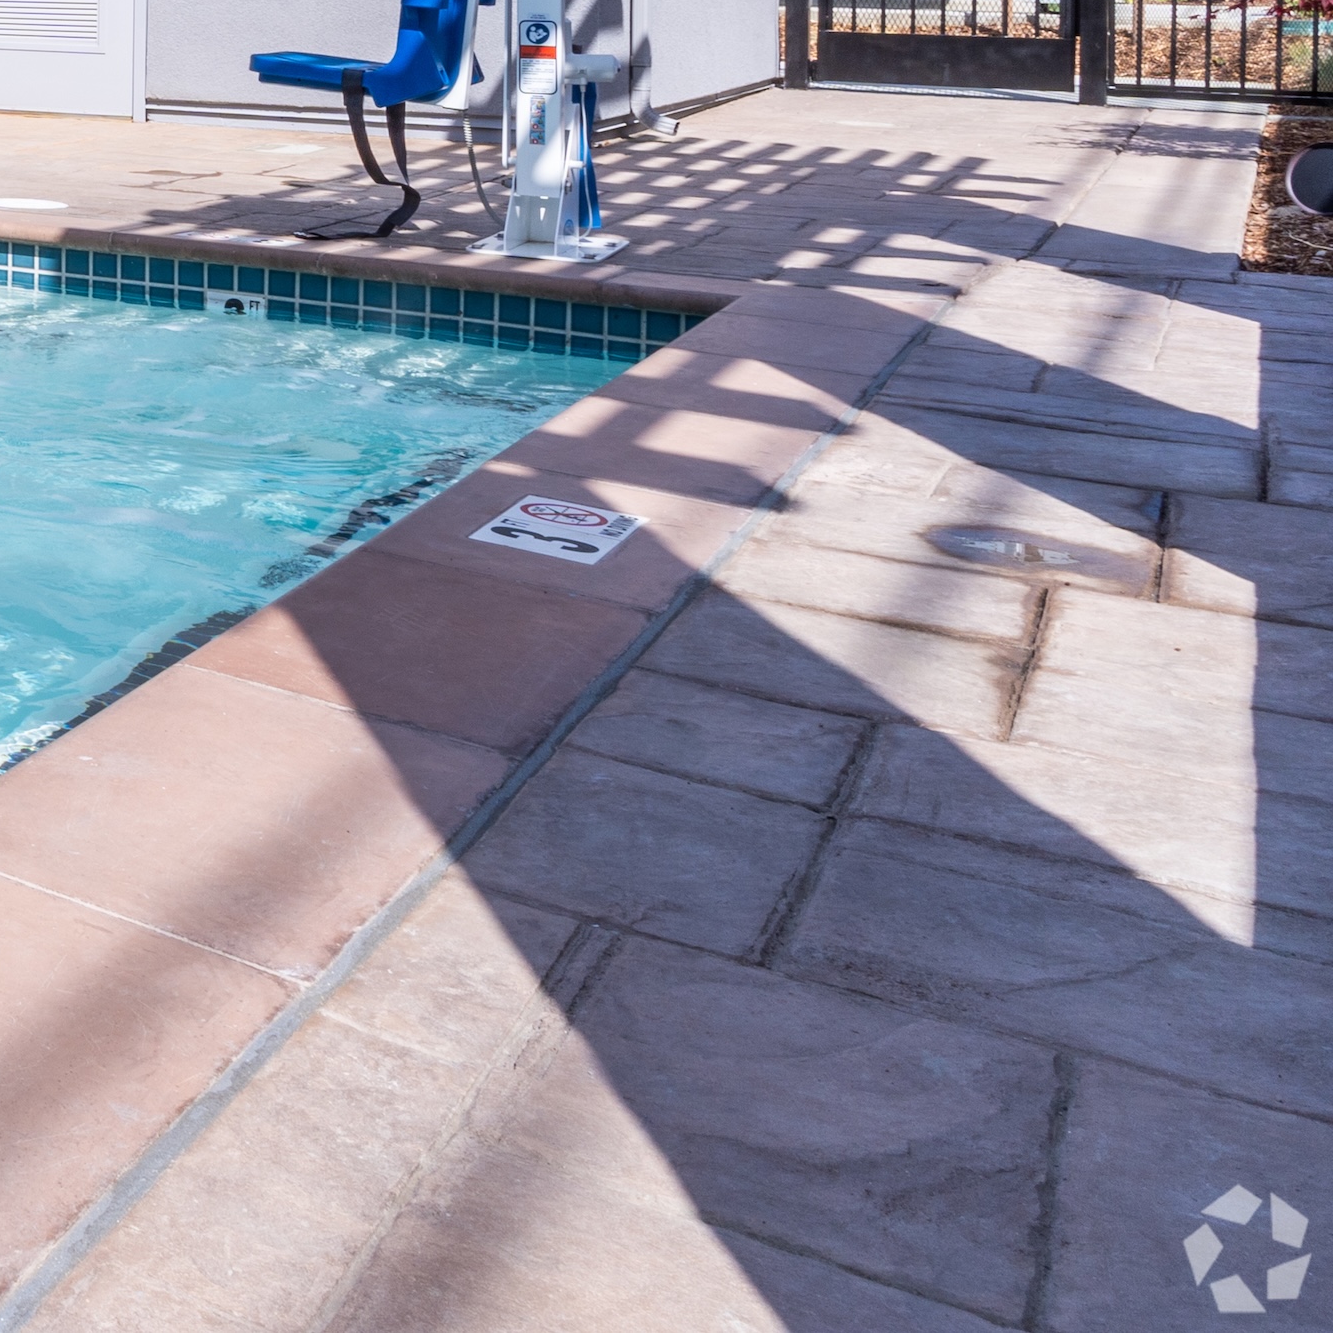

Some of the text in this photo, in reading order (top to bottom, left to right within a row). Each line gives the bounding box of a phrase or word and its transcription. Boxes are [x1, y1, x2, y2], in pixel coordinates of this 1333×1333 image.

[249, 300, 261, 311] FT
[490, 518, 600, 554] 3 FT
